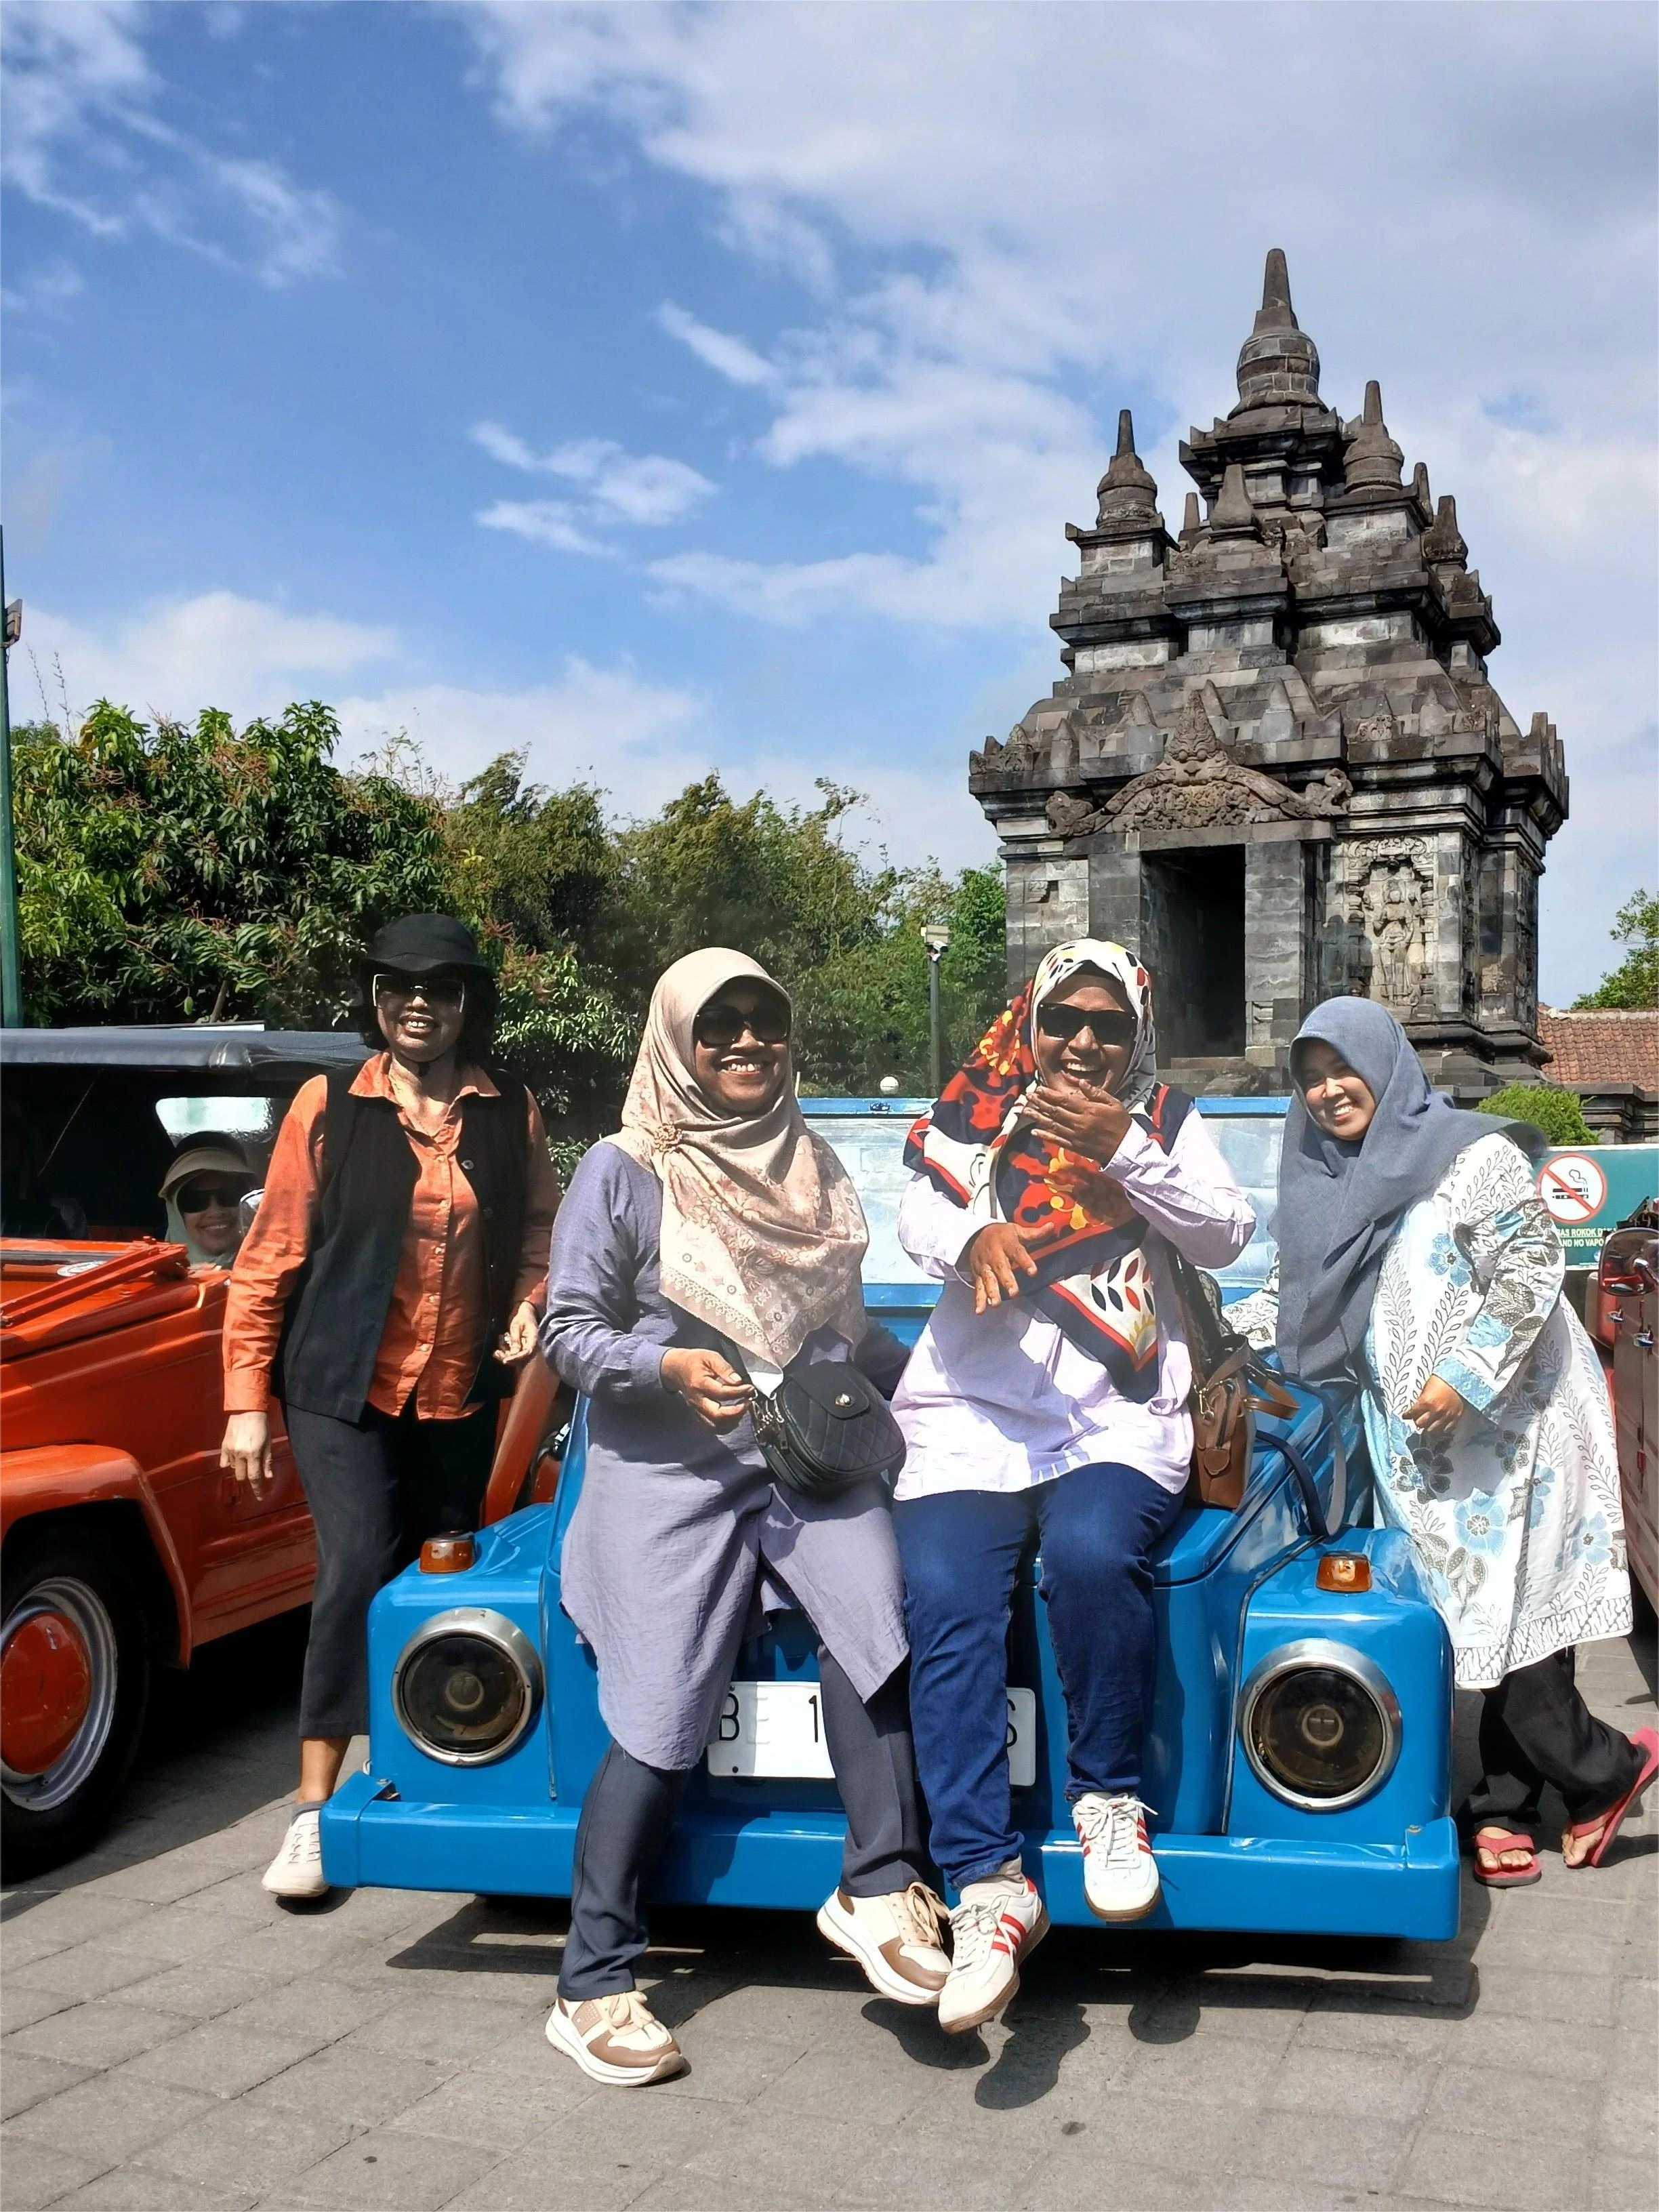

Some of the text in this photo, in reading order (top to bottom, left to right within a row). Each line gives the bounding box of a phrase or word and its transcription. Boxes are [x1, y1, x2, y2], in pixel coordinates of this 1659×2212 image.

[1571, 1228, 1596, 1237] ROKOK
[1574, 1239, 1584, 1247] NO
[1585, 1238, 1604, 1247] VAPO
[719, 1693, 740, 1741] B
